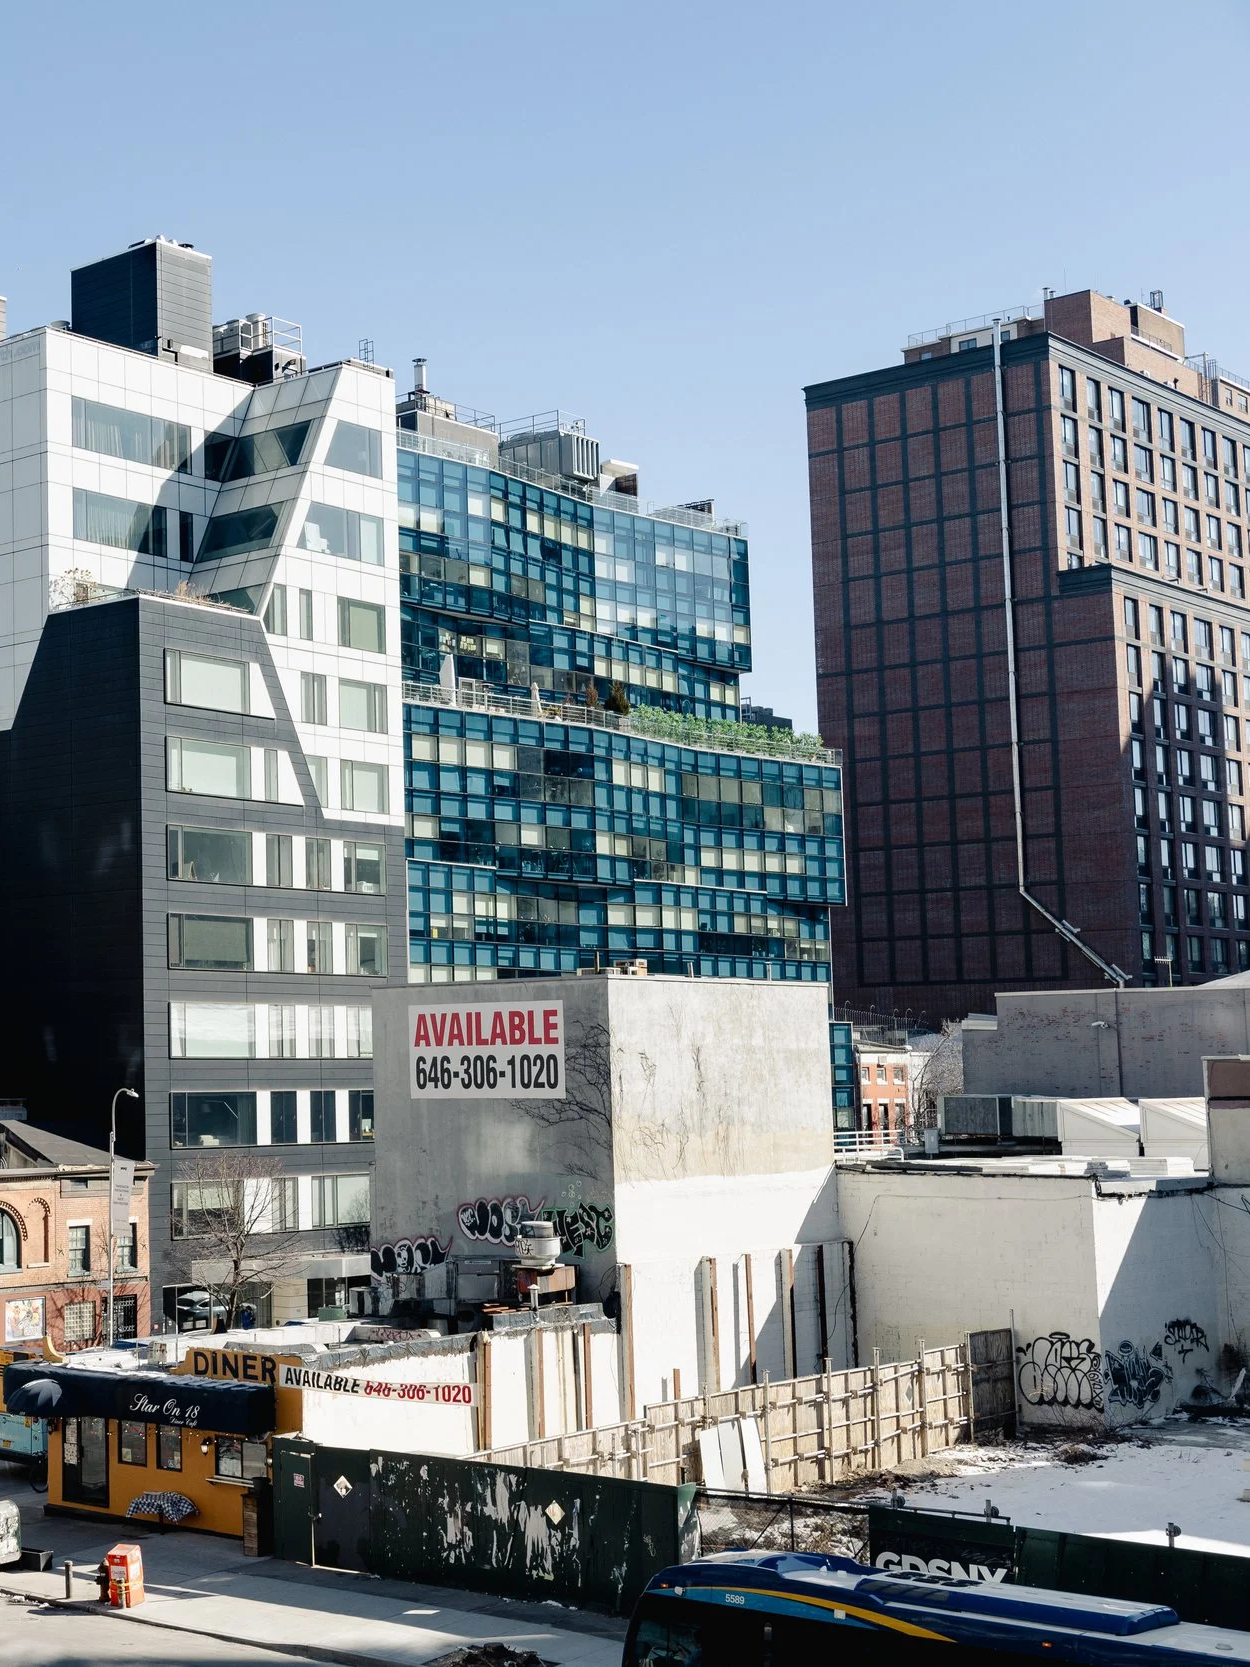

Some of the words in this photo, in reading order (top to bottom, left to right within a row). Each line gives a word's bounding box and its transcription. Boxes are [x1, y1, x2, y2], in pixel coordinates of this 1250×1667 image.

[414, 1009, 559, 1047] AVAILABLE
[416, 1054, 559, 1089] 646-306-1020
[194, 1351, 276, 1384] DINER
[285, 1367, 359, 1394] AVAILABLE
[363, 1383, 472, 1404] 646-306-1020
[130, 1393, 160, 1412] Star
[163, 1399, 180, 1416] On
[185, 1405, 200, 1418] 18
[876, 1551, 1008, 1583] GDSNY
[726, 1594, 745, 1604] 5589
